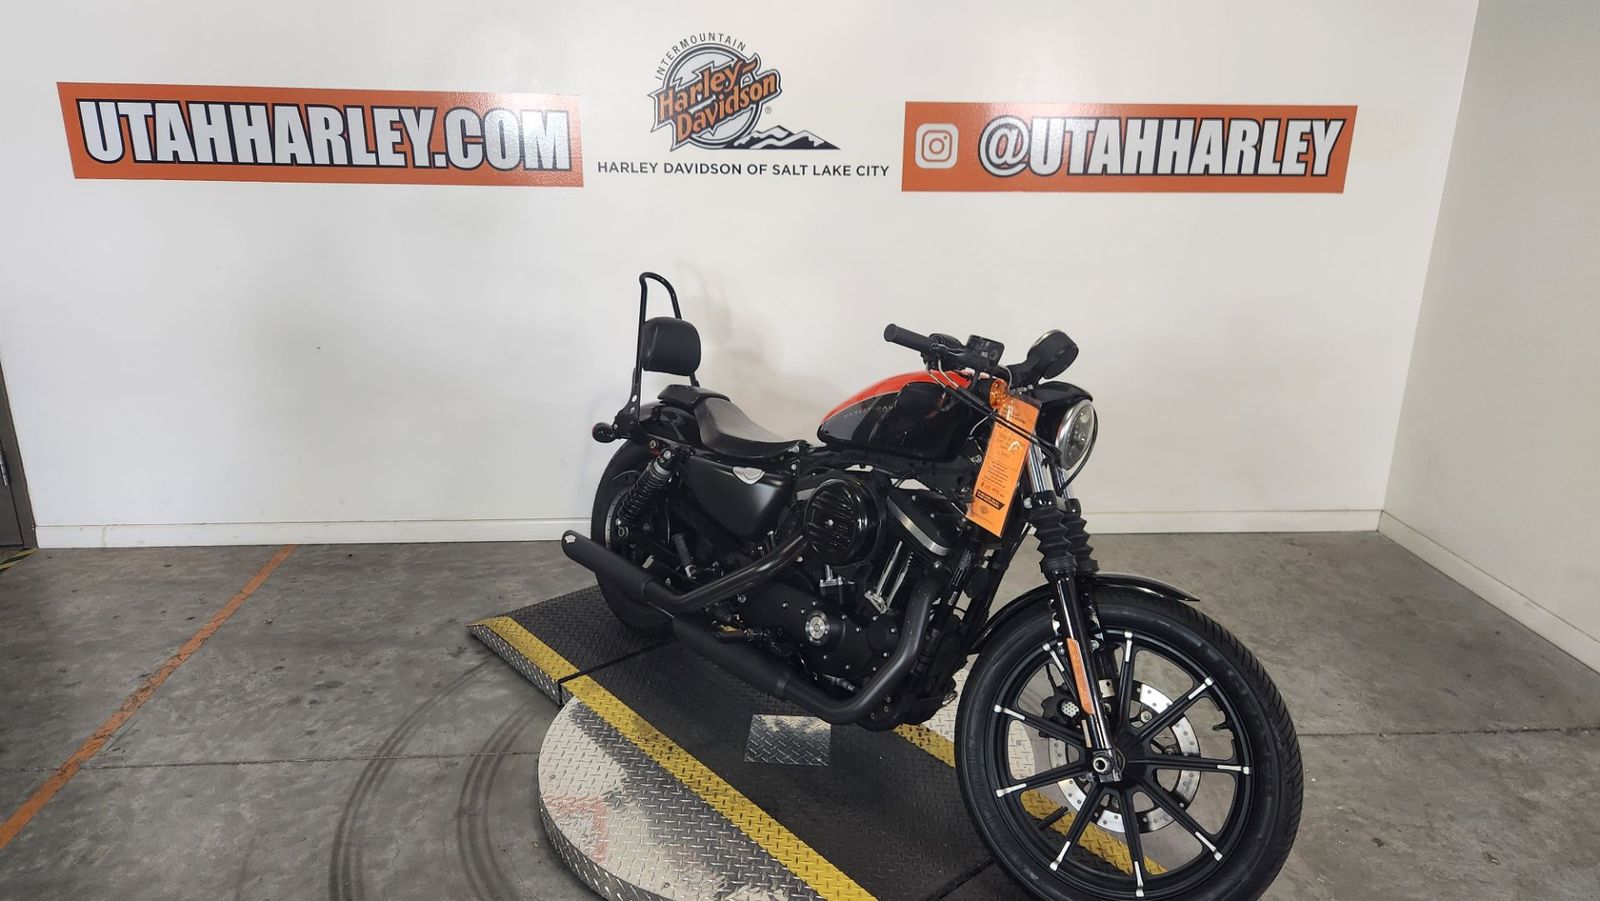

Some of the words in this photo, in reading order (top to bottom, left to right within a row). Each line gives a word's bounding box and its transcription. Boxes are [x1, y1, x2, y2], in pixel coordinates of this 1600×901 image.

[655, 32, 747, 80] INTERMOUNTAIN
[76, 98, 574, 172] UTAHHARLEY.COM
[675, 72, 777, 142] Davidson
[597, 161, 659, 174] HARLEY
[664, 162, 742, 175] DAVIDSON
[747, 164, 768, 176] OF
[772, 164, 808, 176] SALT
[813, 165, 851, 176] LAKE
[856, 165, 890, 177] CITY
[978, 115, 1347, 178] @UTAHHARLEY
